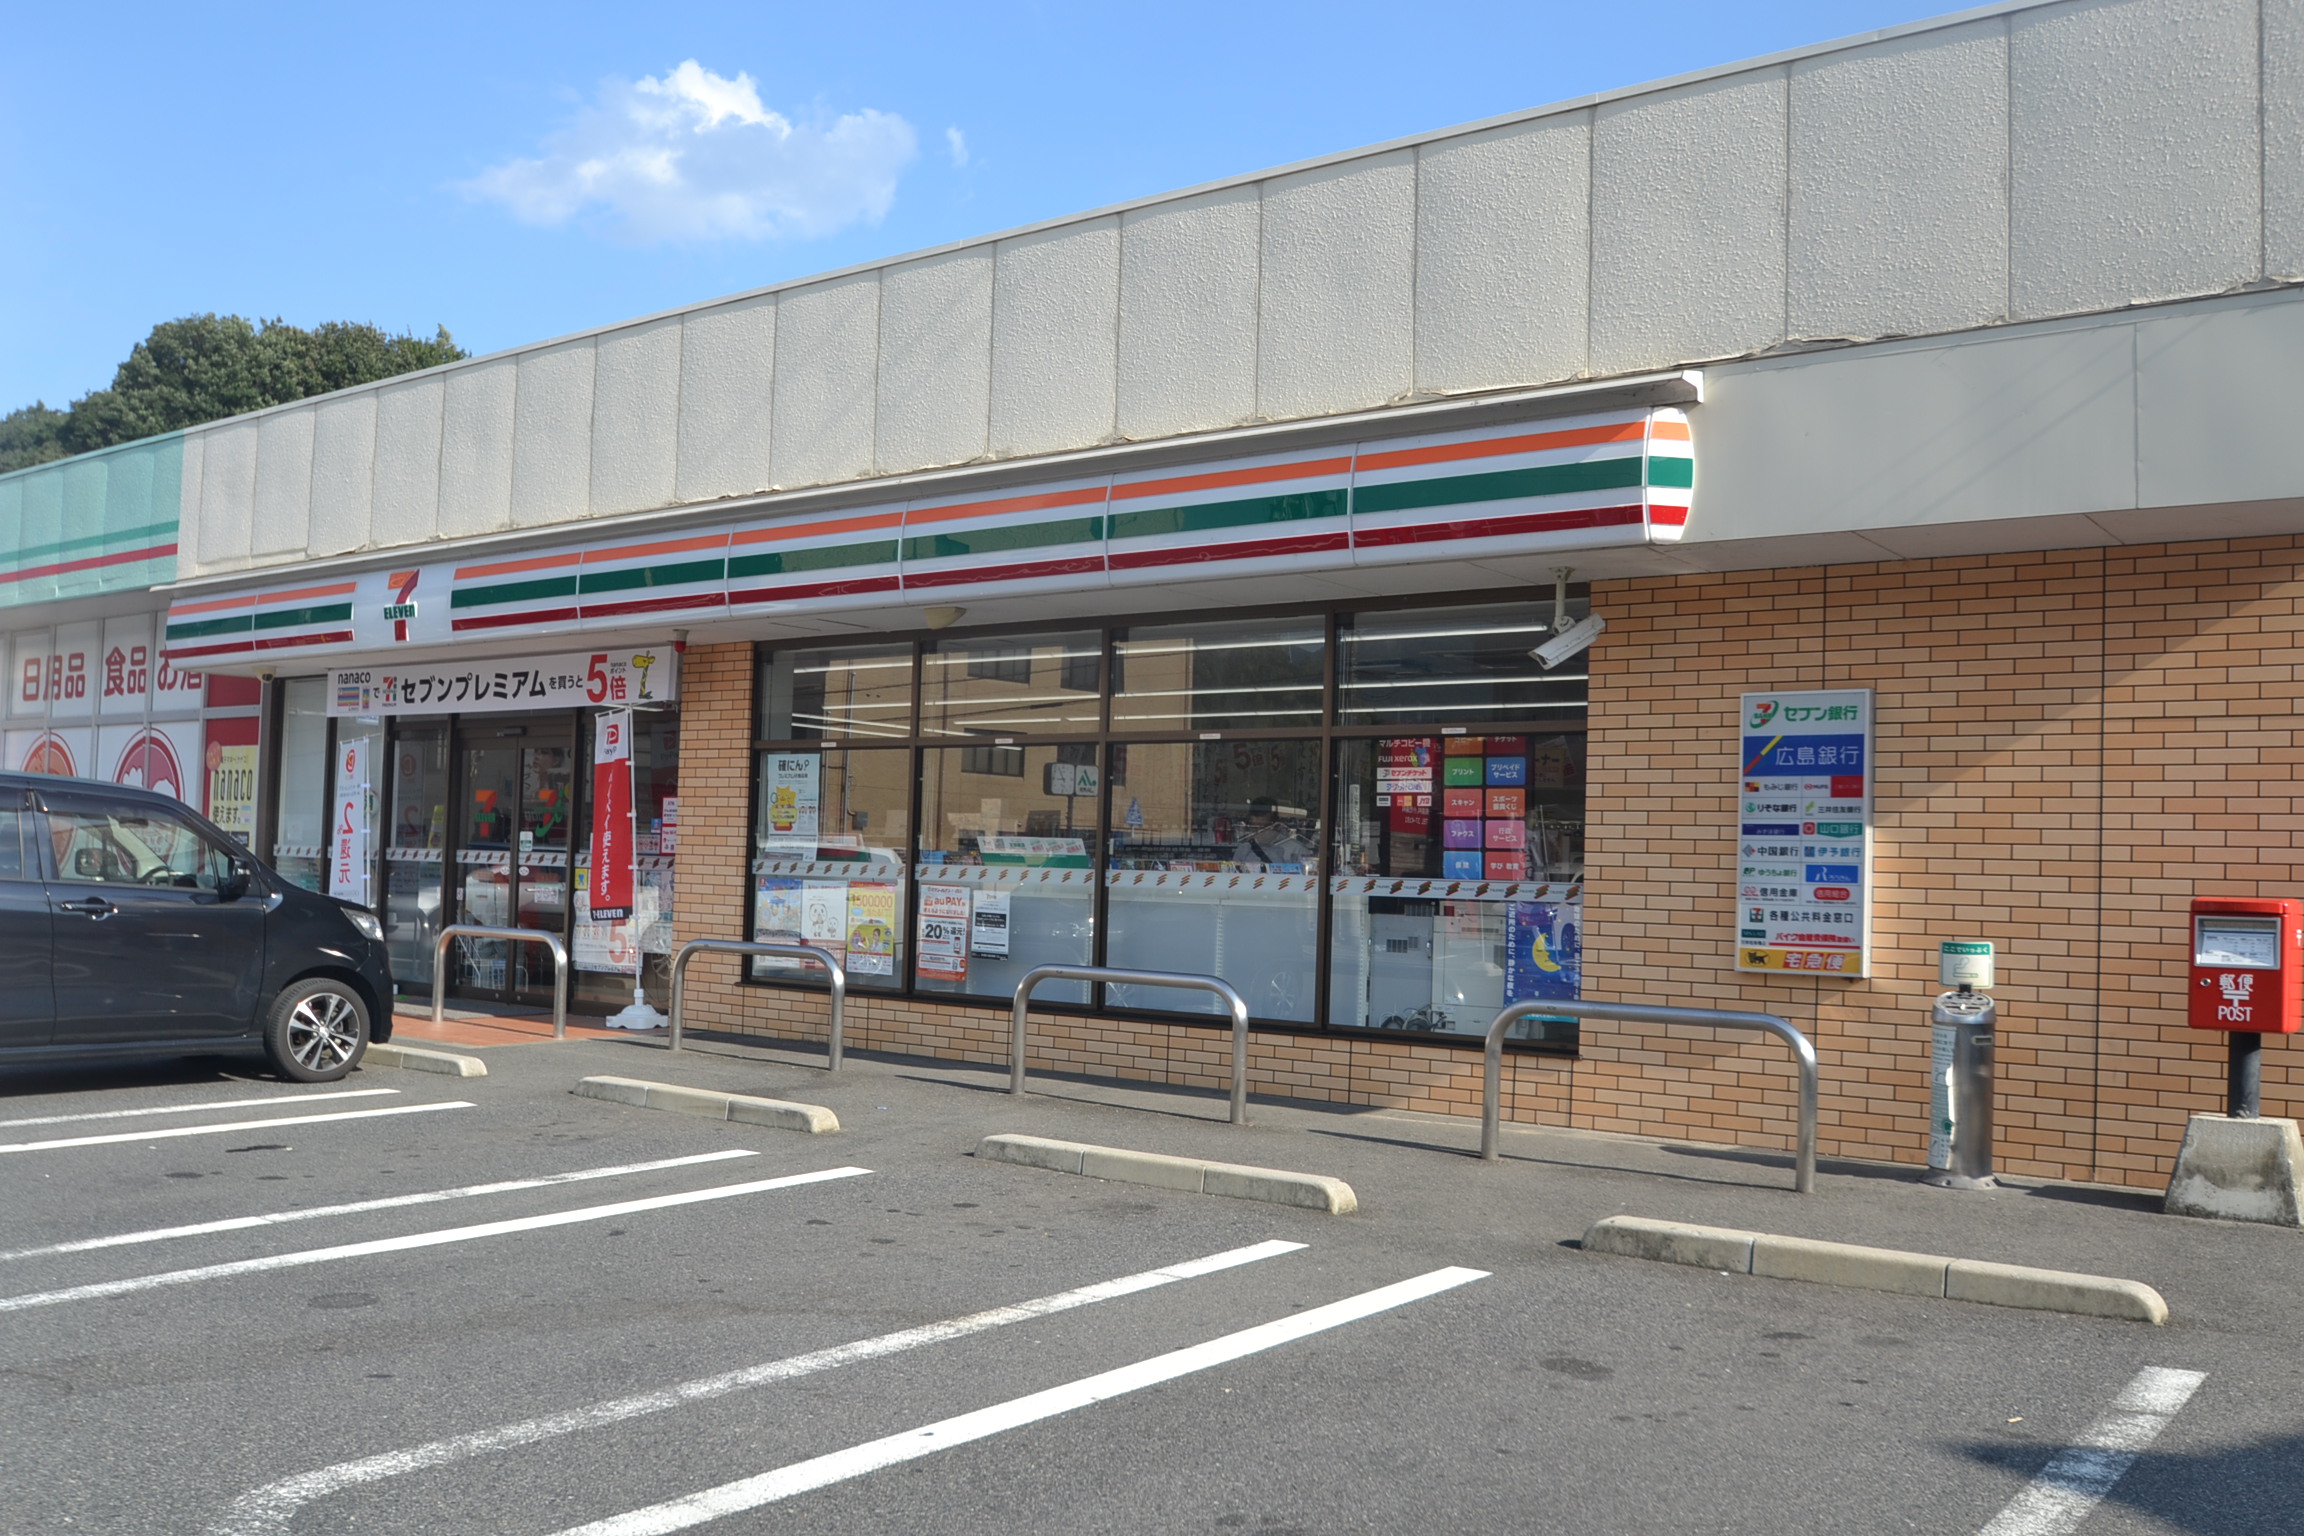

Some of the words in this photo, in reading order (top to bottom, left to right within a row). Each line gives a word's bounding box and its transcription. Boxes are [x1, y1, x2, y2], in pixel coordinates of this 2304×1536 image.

[388, 568, 420, 641] 7
[22, 652, 86, 702] 日用品
[104, 646, 147, 697] 食品
[338, 672, 371, 684] nanaco
[401, 669, 546, 704] セブンプレミアム
[549, 675, 583, 690] を買うと
[373, 687, 380, 699] で
[1378, 737, 1431, 748] マルチコピー機
[1377, 755, 1393, 763] FUJI
[1775, 746, 1860, 766] 広島銀行
[1451, 768, 1475, 776] プリント
[1492, 771, 1518, 779] サービス
[213, 769, 253, 801] nanaco
[1763, 783, 1799, 791] もみじ銀行
[1492, 795, 1518, 803] スポーツ
[1757, 804, 1797, 813] りそな銀行
[1817, 806, 1862, 814] 三井住友銀行
[1451, 830, 1475, 838] ファクス
[1820, 824, 1859, 834] 山口銀行
[1757, 846, 1799, 857] 中国銀行
[1818, 847, 1861, 857] 伊予銀行
[1758, 869, 1797, 877] ゆうちょ銀行
[1760, 887, 1798, 897] 信用金庫
[1816, 889, 1848, 898] 信用組合
[1769, 910, 1854, 923] 各種公共料金窓口
[1943, 945, 1989, 954] ここでいっぷく
[1785, 952, 1845, 970] 宅急便
[2219, 973, 2254, 992] 郵便
[2217, 1005, 2253, 1022] POST
